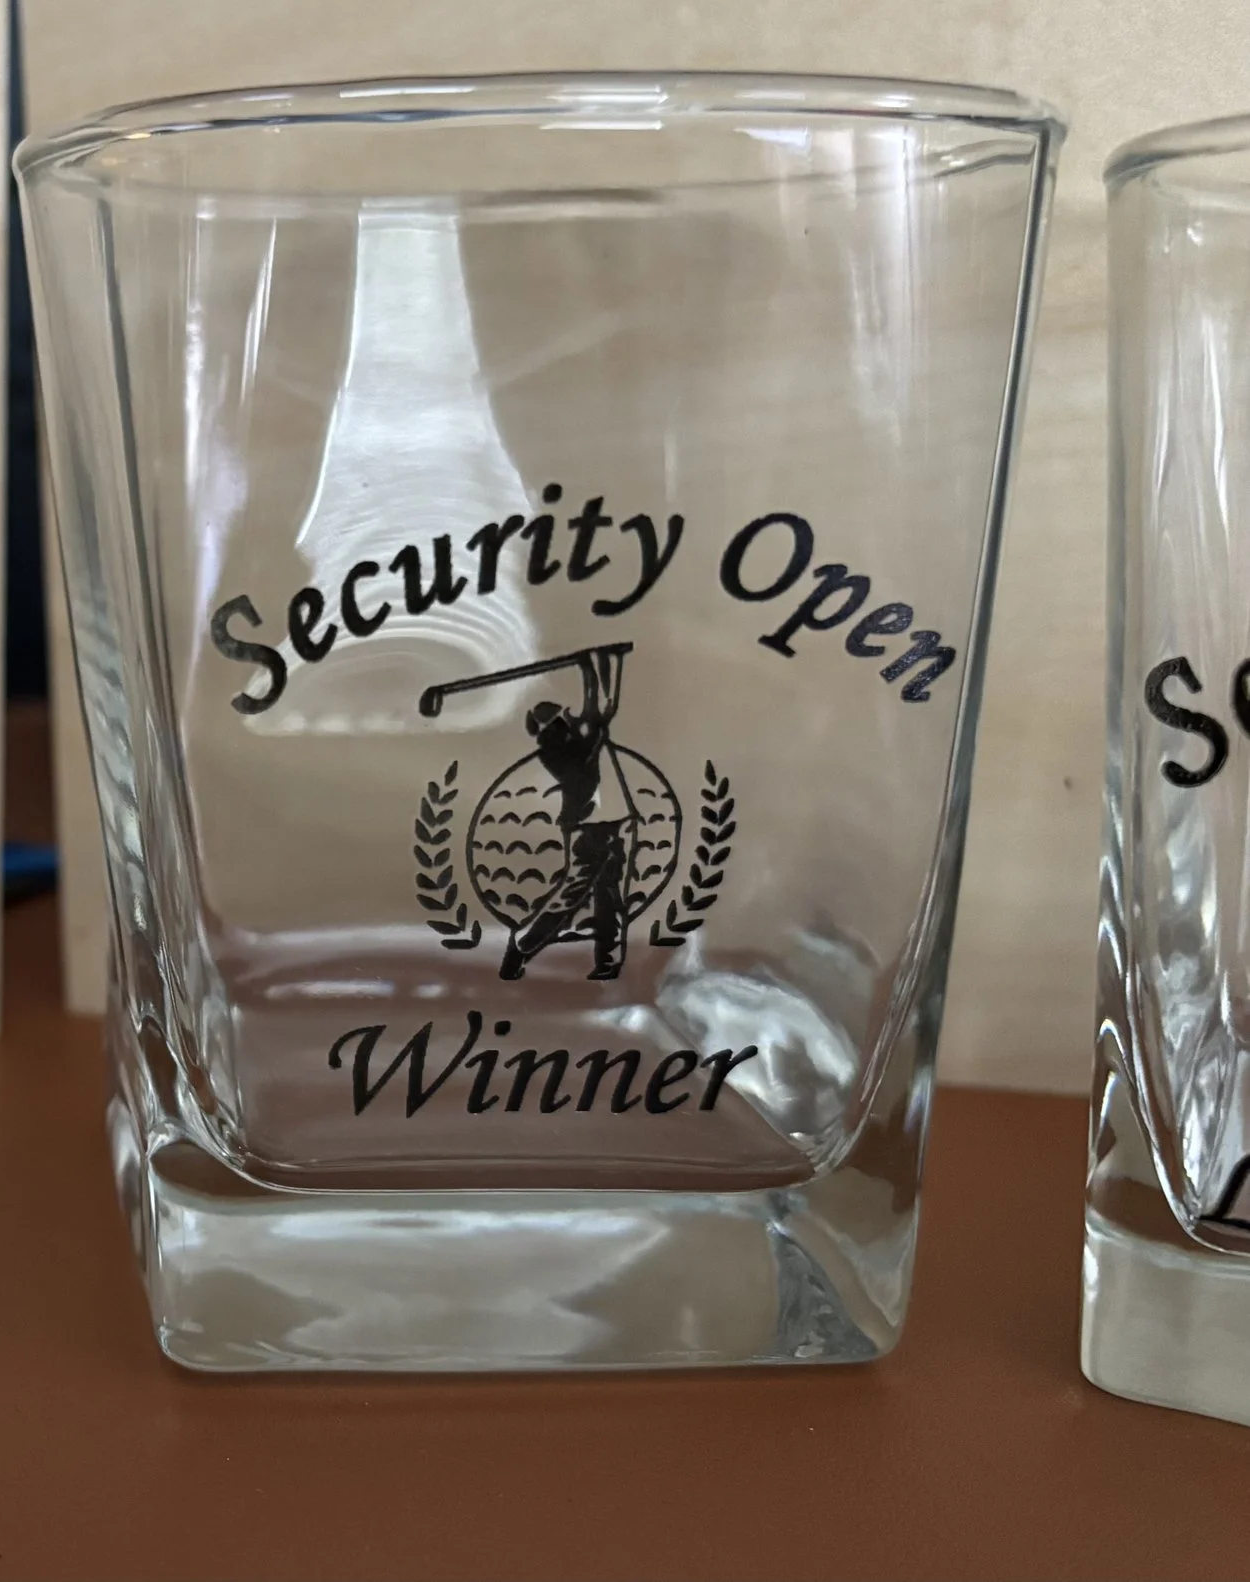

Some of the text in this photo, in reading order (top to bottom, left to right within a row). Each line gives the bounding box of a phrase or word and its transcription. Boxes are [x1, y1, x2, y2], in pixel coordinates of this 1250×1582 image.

[209, 484, 956, 715] Security Open
[328, 1010, 758, 1118] Winner
